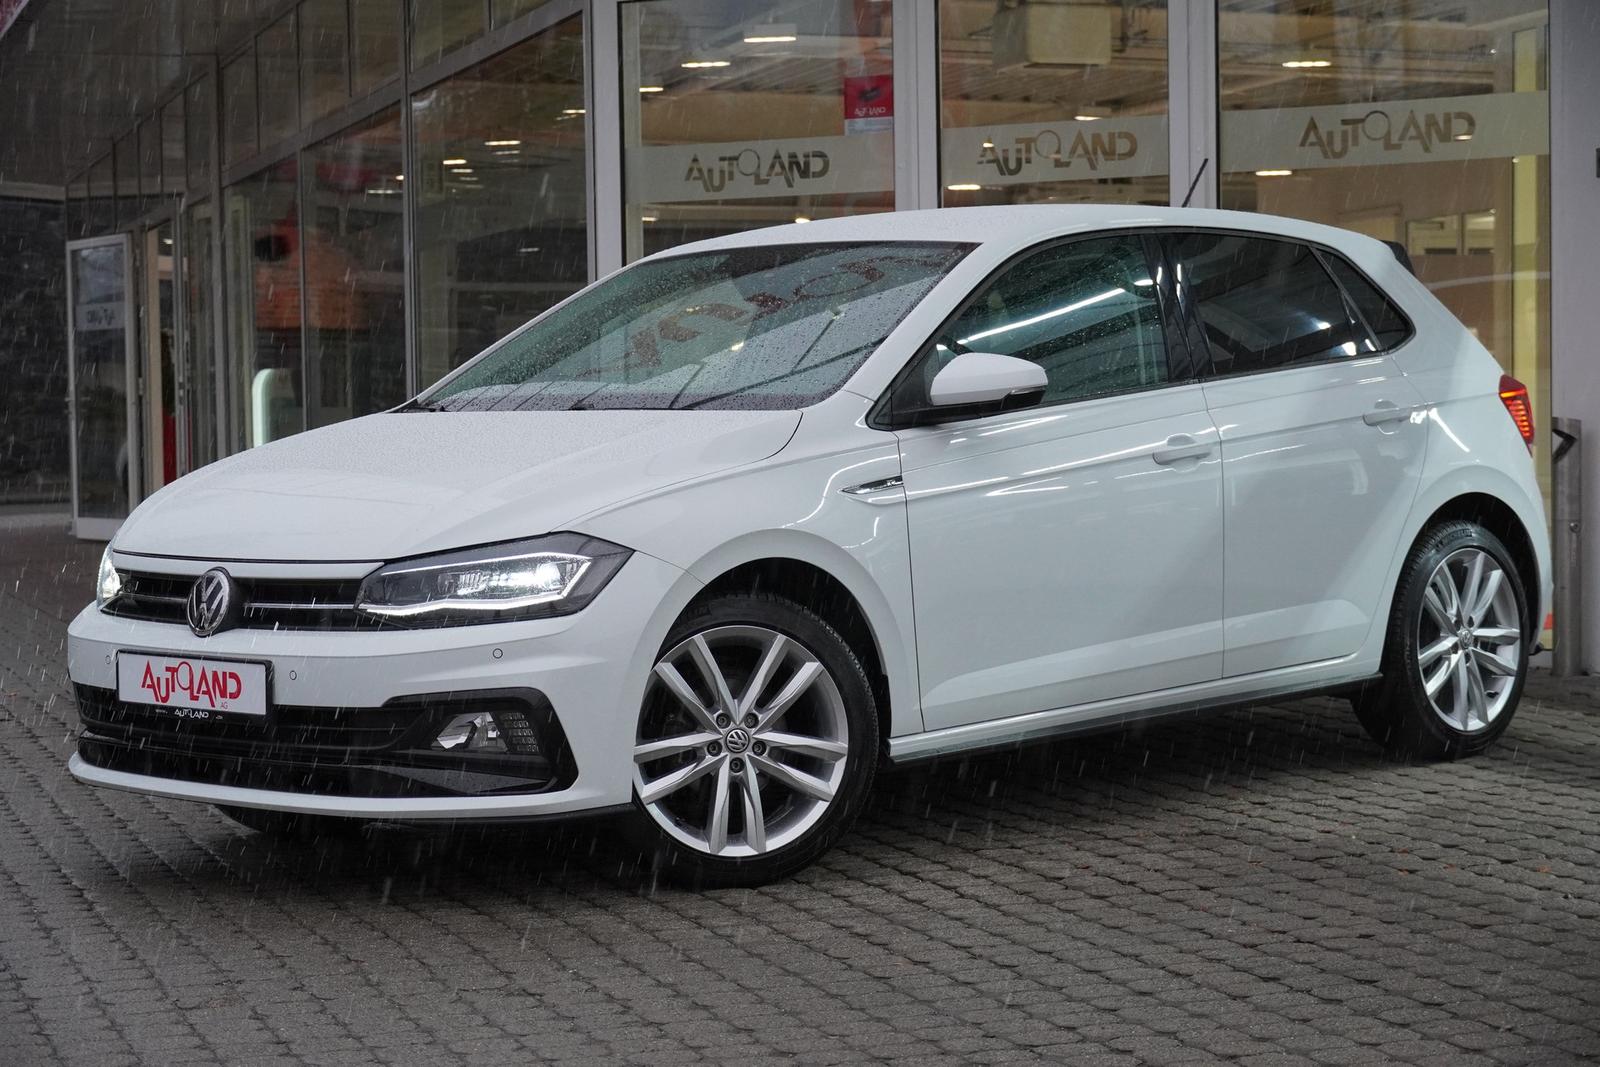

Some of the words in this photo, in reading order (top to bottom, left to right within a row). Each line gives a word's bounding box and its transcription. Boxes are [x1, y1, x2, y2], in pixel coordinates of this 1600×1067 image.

[977, 129, 1138, 176] AUTOLAND
[1298, 109, 1477, 159] AUTOLAND
[684, 148, 831, 192] AUTOLAND
[141, 660, 242, 708] AUTOLAND
